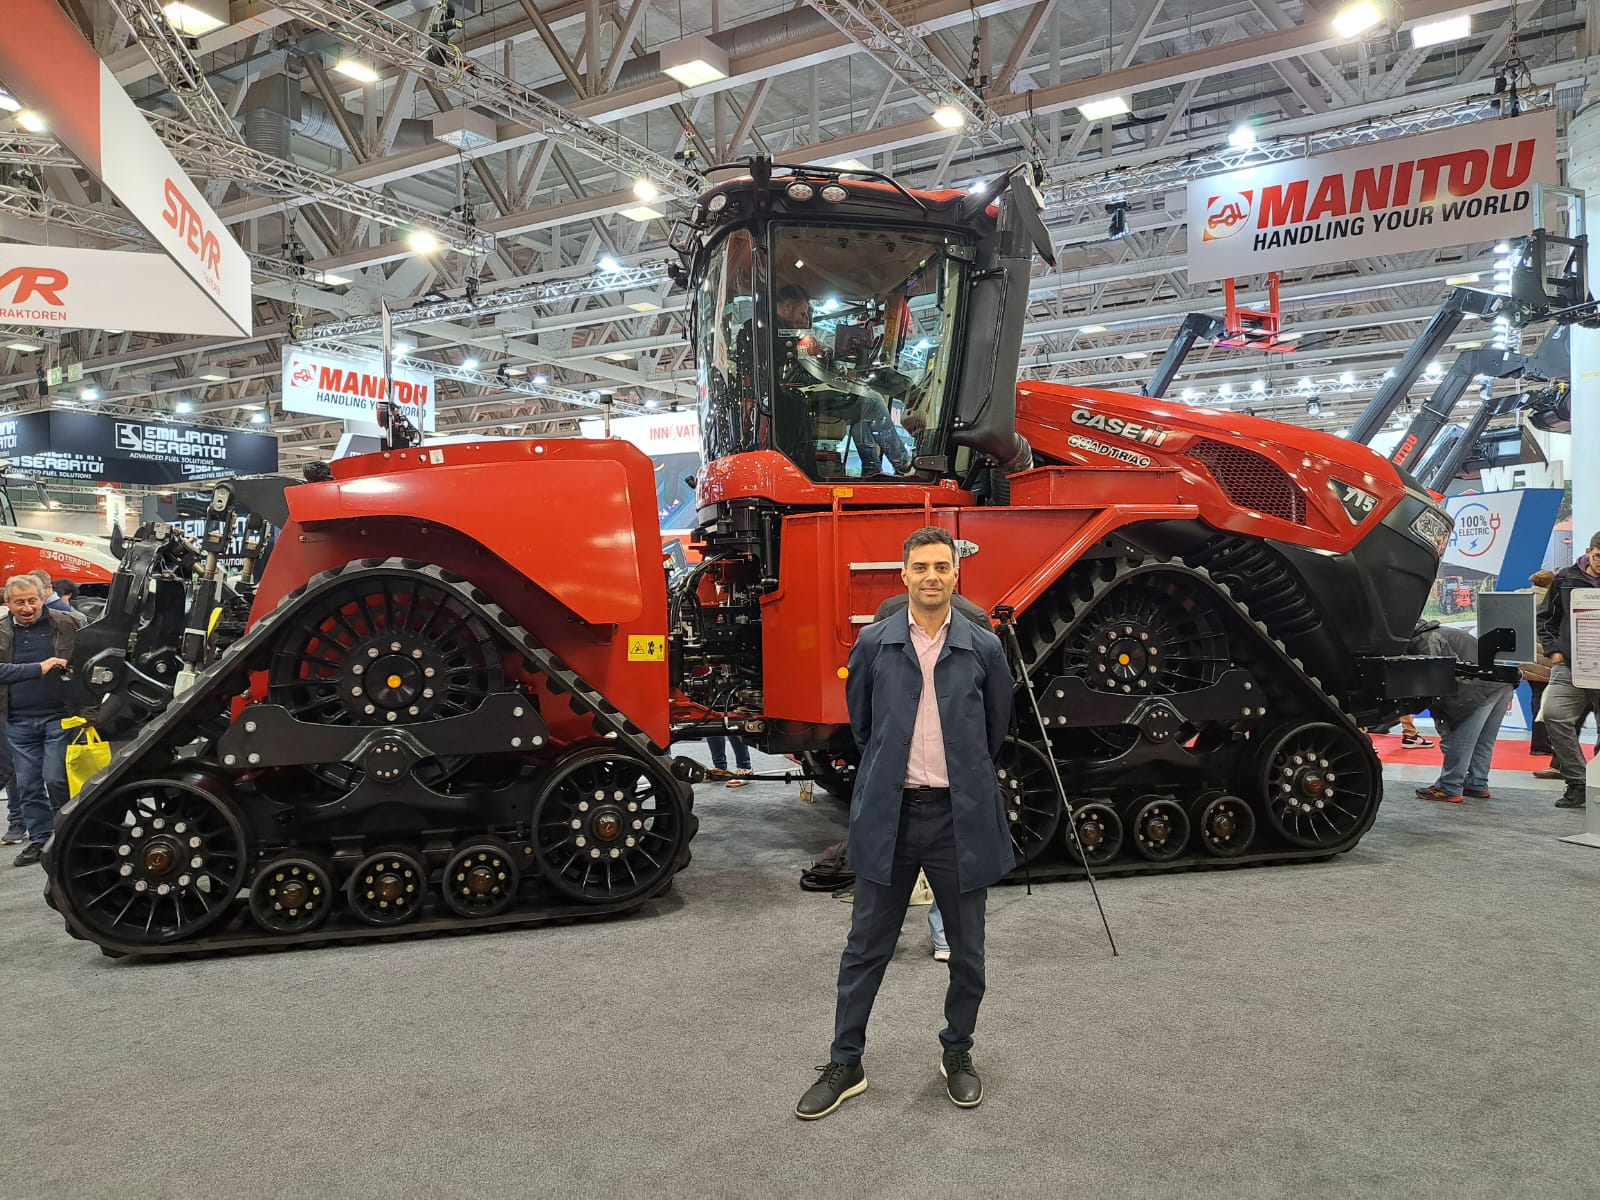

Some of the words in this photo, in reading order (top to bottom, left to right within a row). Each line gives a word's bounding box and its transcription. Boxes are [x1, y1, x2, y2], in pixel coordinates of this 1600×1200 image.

[1257, 138, 1536, 229] MANITOU
[162, 178, 221, 280] STEYR
[1253, 217, 1364, 251] HANDLING
[1372, 204, 1434, 233] YOUR
[1442, 190, 1529, 222] WORLD
[316, 391, 367, 409] HANDLING
[1071, 409, 1143, 441] CASE
[144, 426, 224, 446] EMILIANA
[129, 452, 163, 461] ADVANCED
[164, 455, 181, 463] FUEL
[181, 457, 214, 465] SOLUTIONS
[143, 440, 226, 459] SERBATOI
[1067, 435, 1151, 468] QUADTRAC
[21, 455, 104, 473] SERBATOI
[1343, 487, 1376, 512] 715
[1461, 515, 1488, 528] 100%
[53, 536, 85, 547] STEYR
[1459, 527, 1490, 537] ELECTRIC
